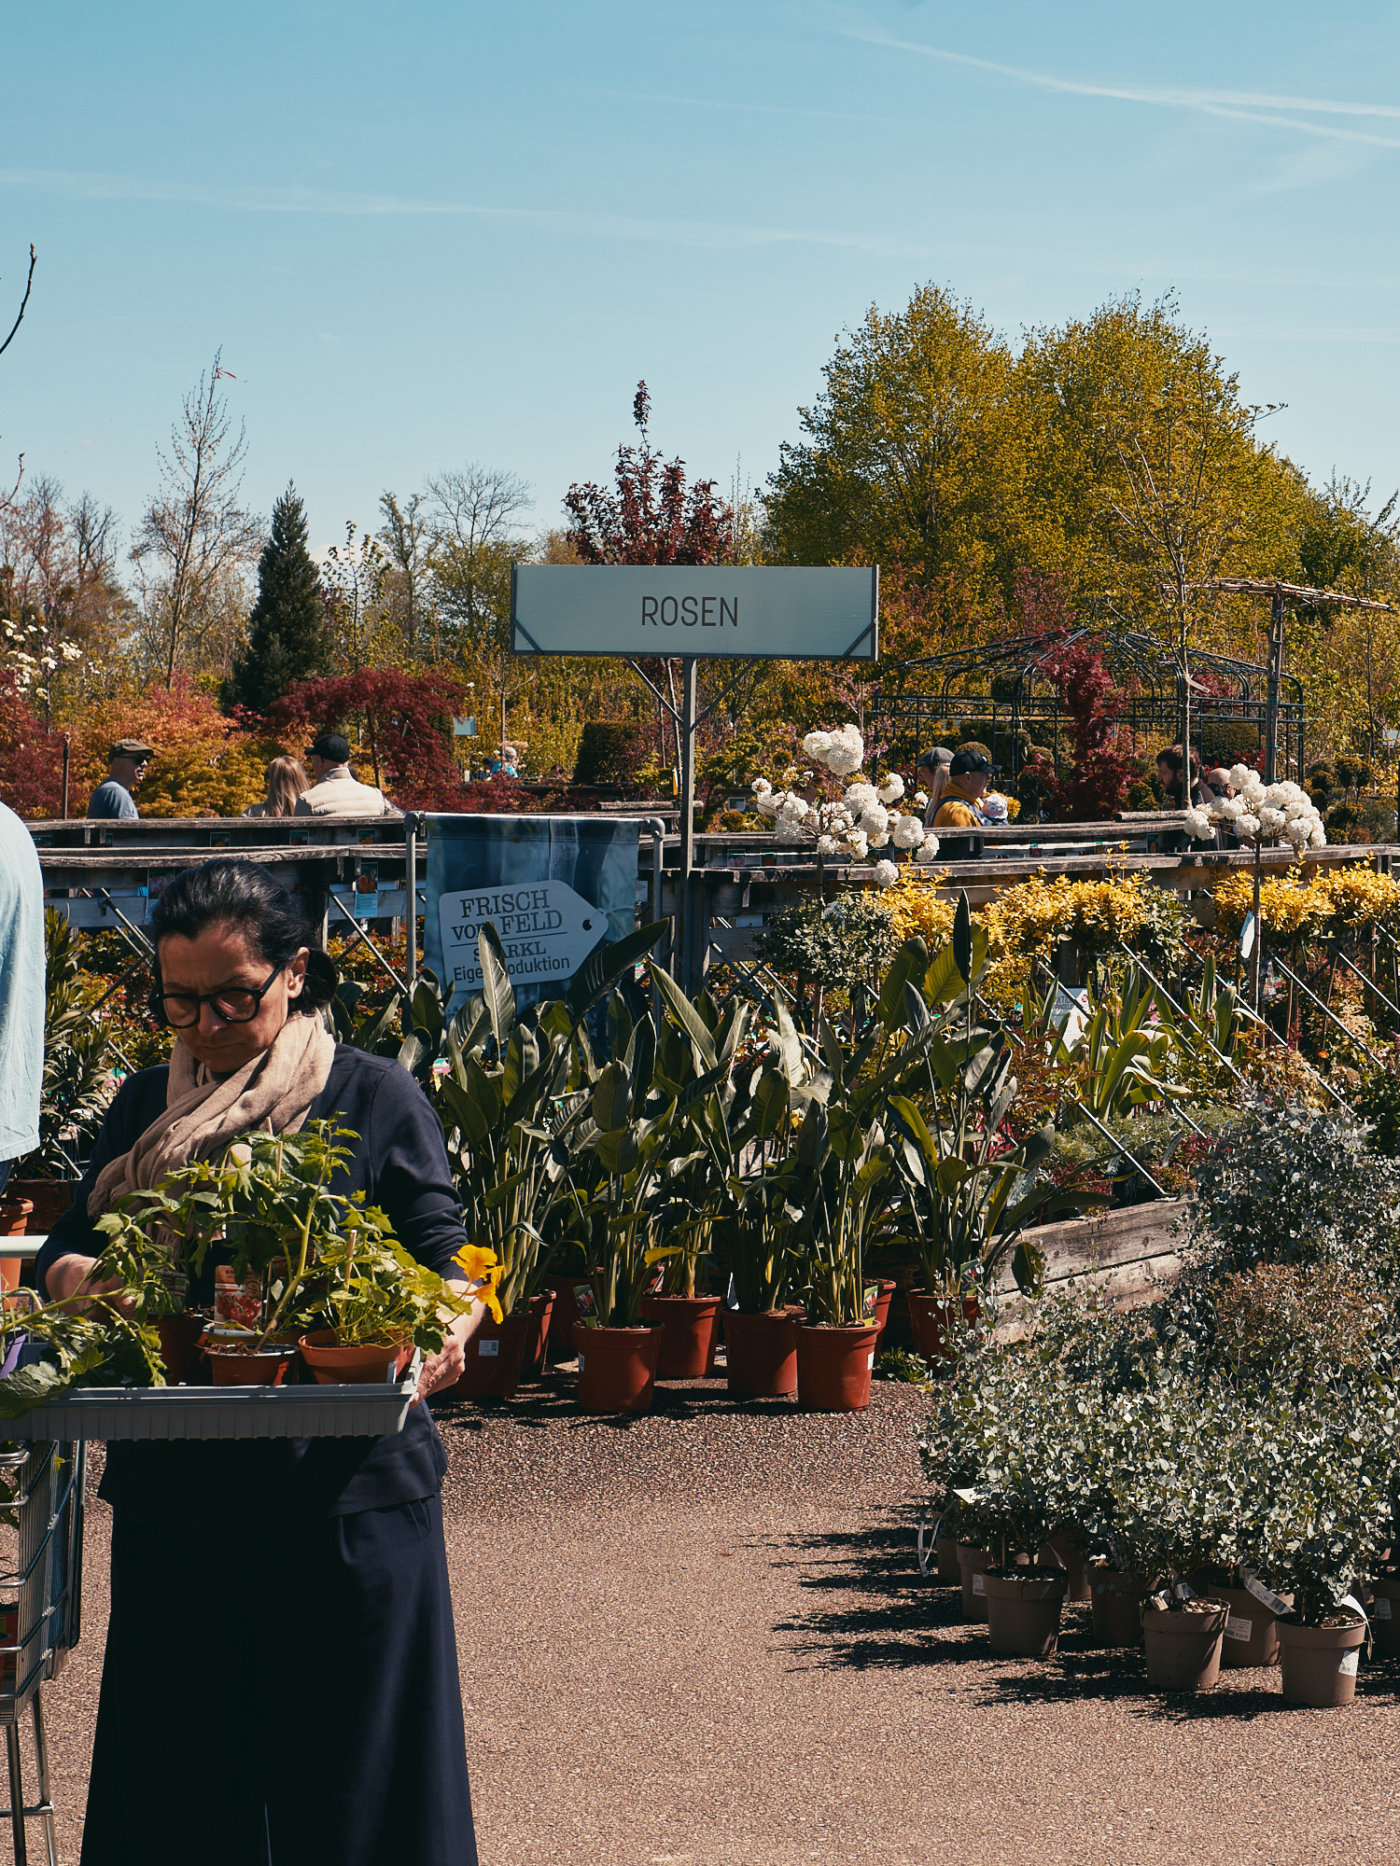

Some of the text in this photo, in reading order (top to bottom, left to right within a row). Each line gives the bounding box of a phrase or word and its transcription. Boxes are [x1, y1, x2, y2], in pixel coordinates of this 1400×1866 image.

[641, 595, 738, 627] ROSEN
[459, 889, 551, 919] FRISCH
[451, 909, 563, 941] vo FELD
[473, 941, 547, 963] SRKL
[453, 956, 570, 984] Eigeoduktion
